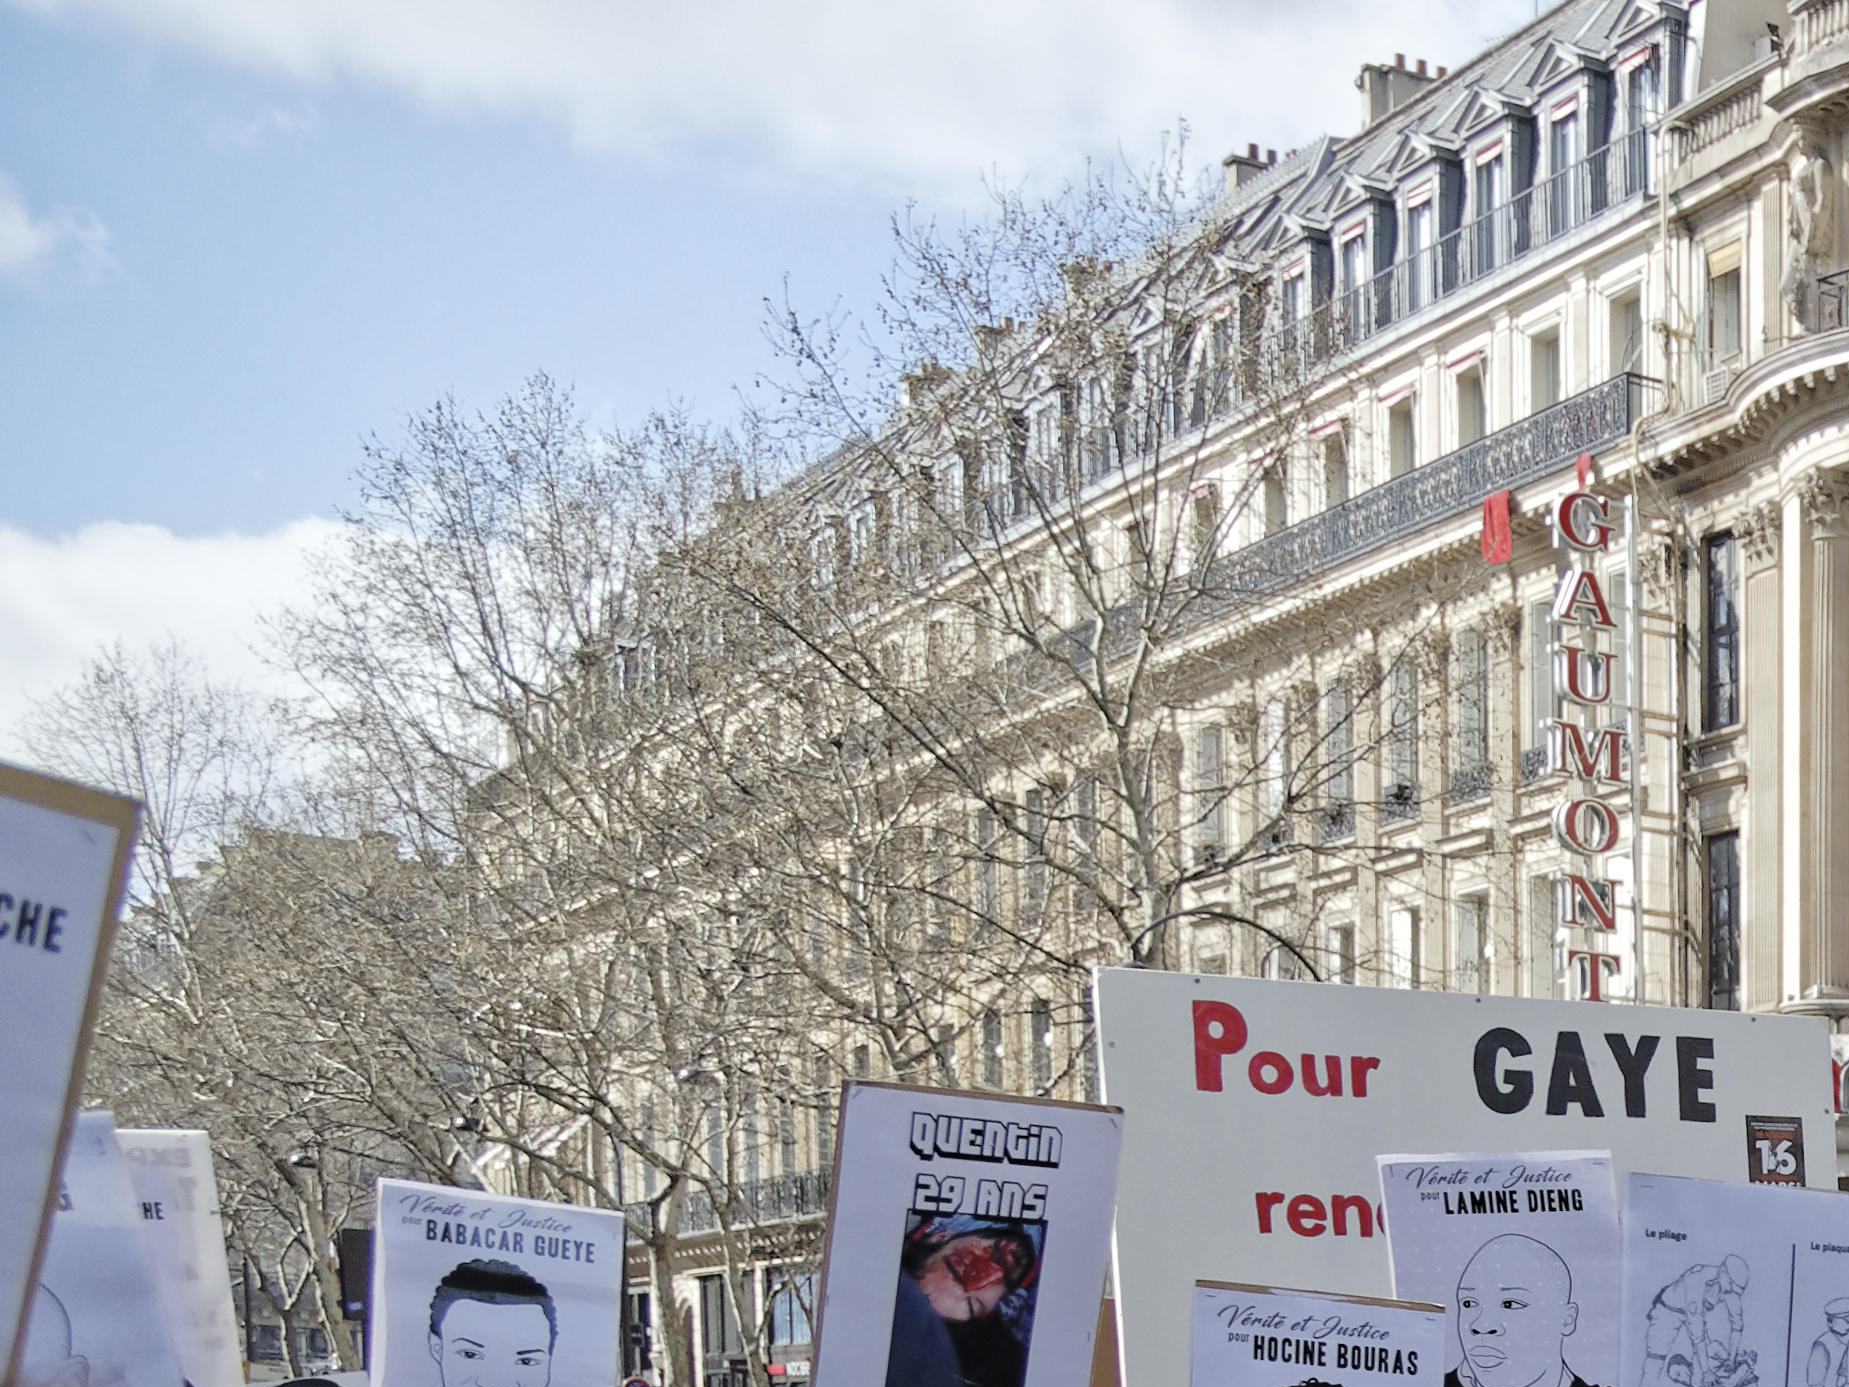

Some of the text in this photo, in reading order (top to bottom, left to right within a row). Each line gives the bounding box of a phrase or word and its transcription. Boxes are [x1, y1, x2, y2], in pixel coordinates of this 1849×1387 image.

[1552, 492, 1634, 1002] GAUMONT
[1191, 999, 1716, 1124] Pour GAYE
[1405, 1164, 1573, 1189] Vérité et Justice
[1755, 1139, 1797, 1176] 16
[400, 1194, 574, 1233] Vérité et Justice
[914, 1173, 1049, 1222] 29 ANS
[1420, 1188, 1584, 1216] pour LAMINE DIENG
[425, 1218, 525, 1253] BABACAR
[533, 1234, 597, 1264] GUEYE
[1645, 1228, 1688, 1242] Le pliage
[1810, 1241, 1820, 1251] Le
[1217, 1304, 1390, 1340] Vérité et Justice
[1228, 1331, 1419, 1376] pour HOCINE BOURAS
